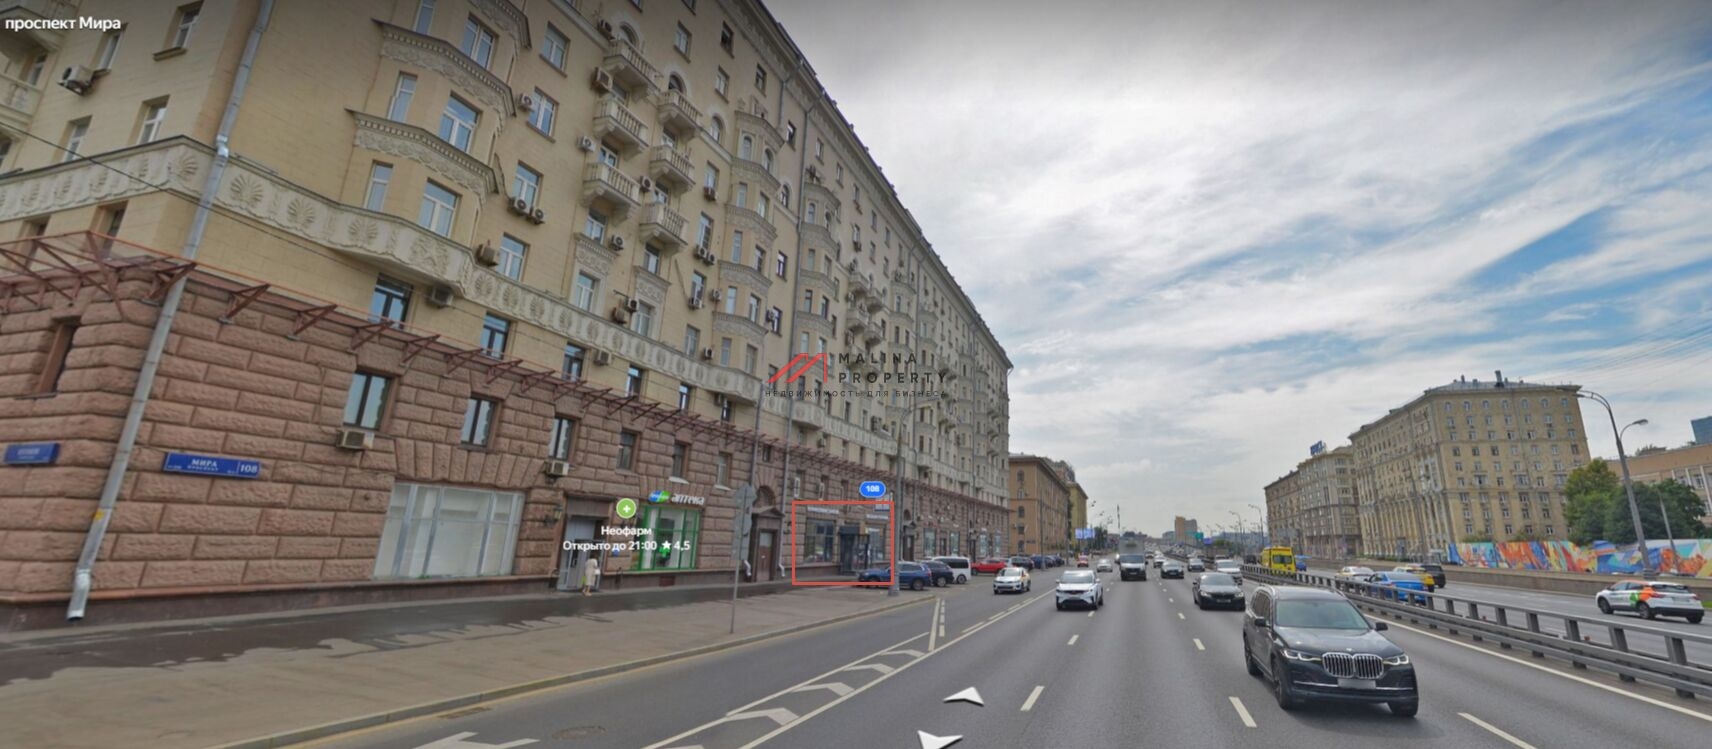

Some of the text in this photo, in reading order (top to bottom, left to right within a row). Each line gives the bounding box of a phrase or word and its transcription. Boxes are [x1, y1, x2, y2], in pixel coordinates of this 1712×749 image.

[191, 459, 217, 467] МИРА
[240, 464, 258, 473] 108
[671, 493, 705, 505] аптека
